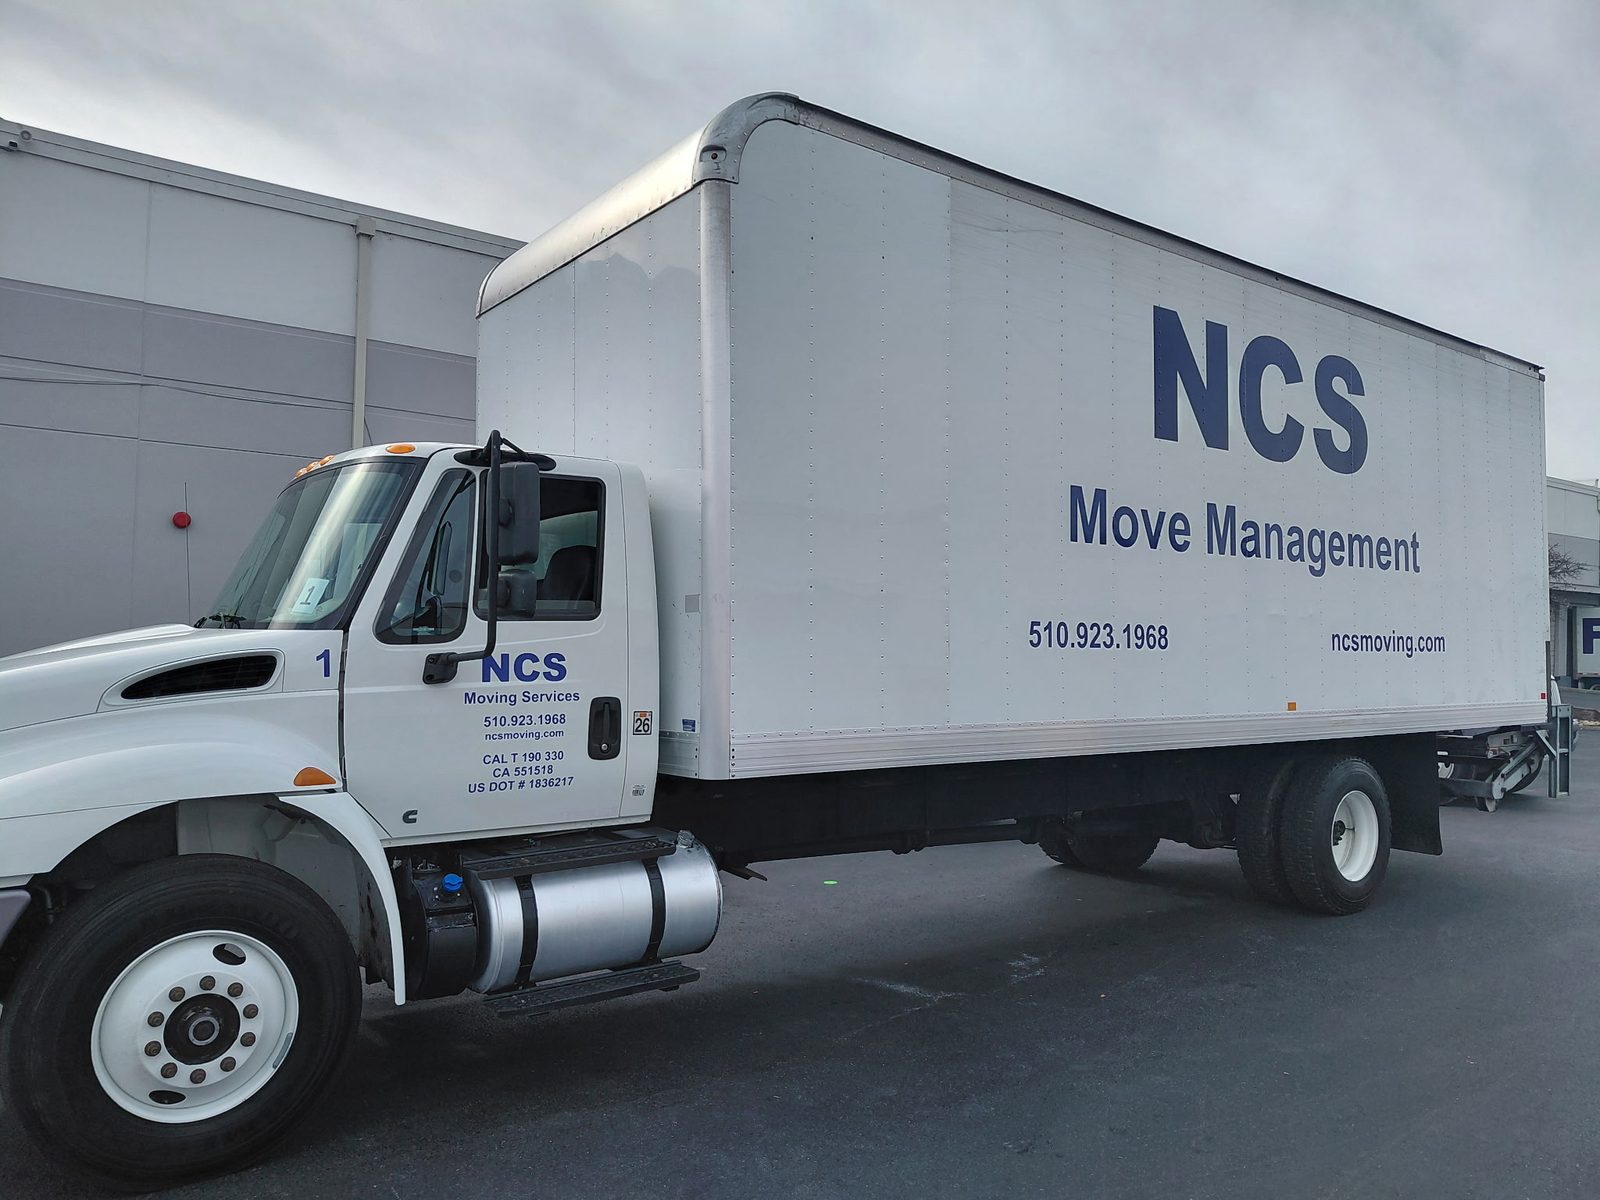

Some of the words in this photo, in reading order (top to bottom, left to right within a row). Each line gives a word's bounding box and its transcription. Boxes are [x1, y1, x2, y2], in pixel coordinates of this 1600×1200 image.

[1153, 305, 1368, 475] NCS
[1069, 485, 1191, 553] Move
[1206, 503, 1421, 577] Management
[300, 586, 315, 605] 1
[1028, 621, 1169, 651] 510.923.1968
[1330, 631, 1447, 659] ncsmoving.com
[315, 649, 331, 678] 1
[481, 652, 567, 683] NCS
[464, 692, 517, 706] Moving
[522, 690, 580, 703] Services
[483, 713, 566, 727] 510.923.1968
[634, 718, 650, 733] 26
[484, 729, 564, 741] ncsmoving.com
[482, 754, 508, 765] CAL
[510, 752, 518, 763] T
[522, 752, 542, 762] 190
[544, 750, 564, 761] 330
[492, 768, 510, 778] CA
[514, 764, 554, 777] 551518
[468, 782, 485, 793] US
[489, 780, 515, 792] DOT
[518, 779, 526, 789] #
[528, 776, 574, 789] 1836217
